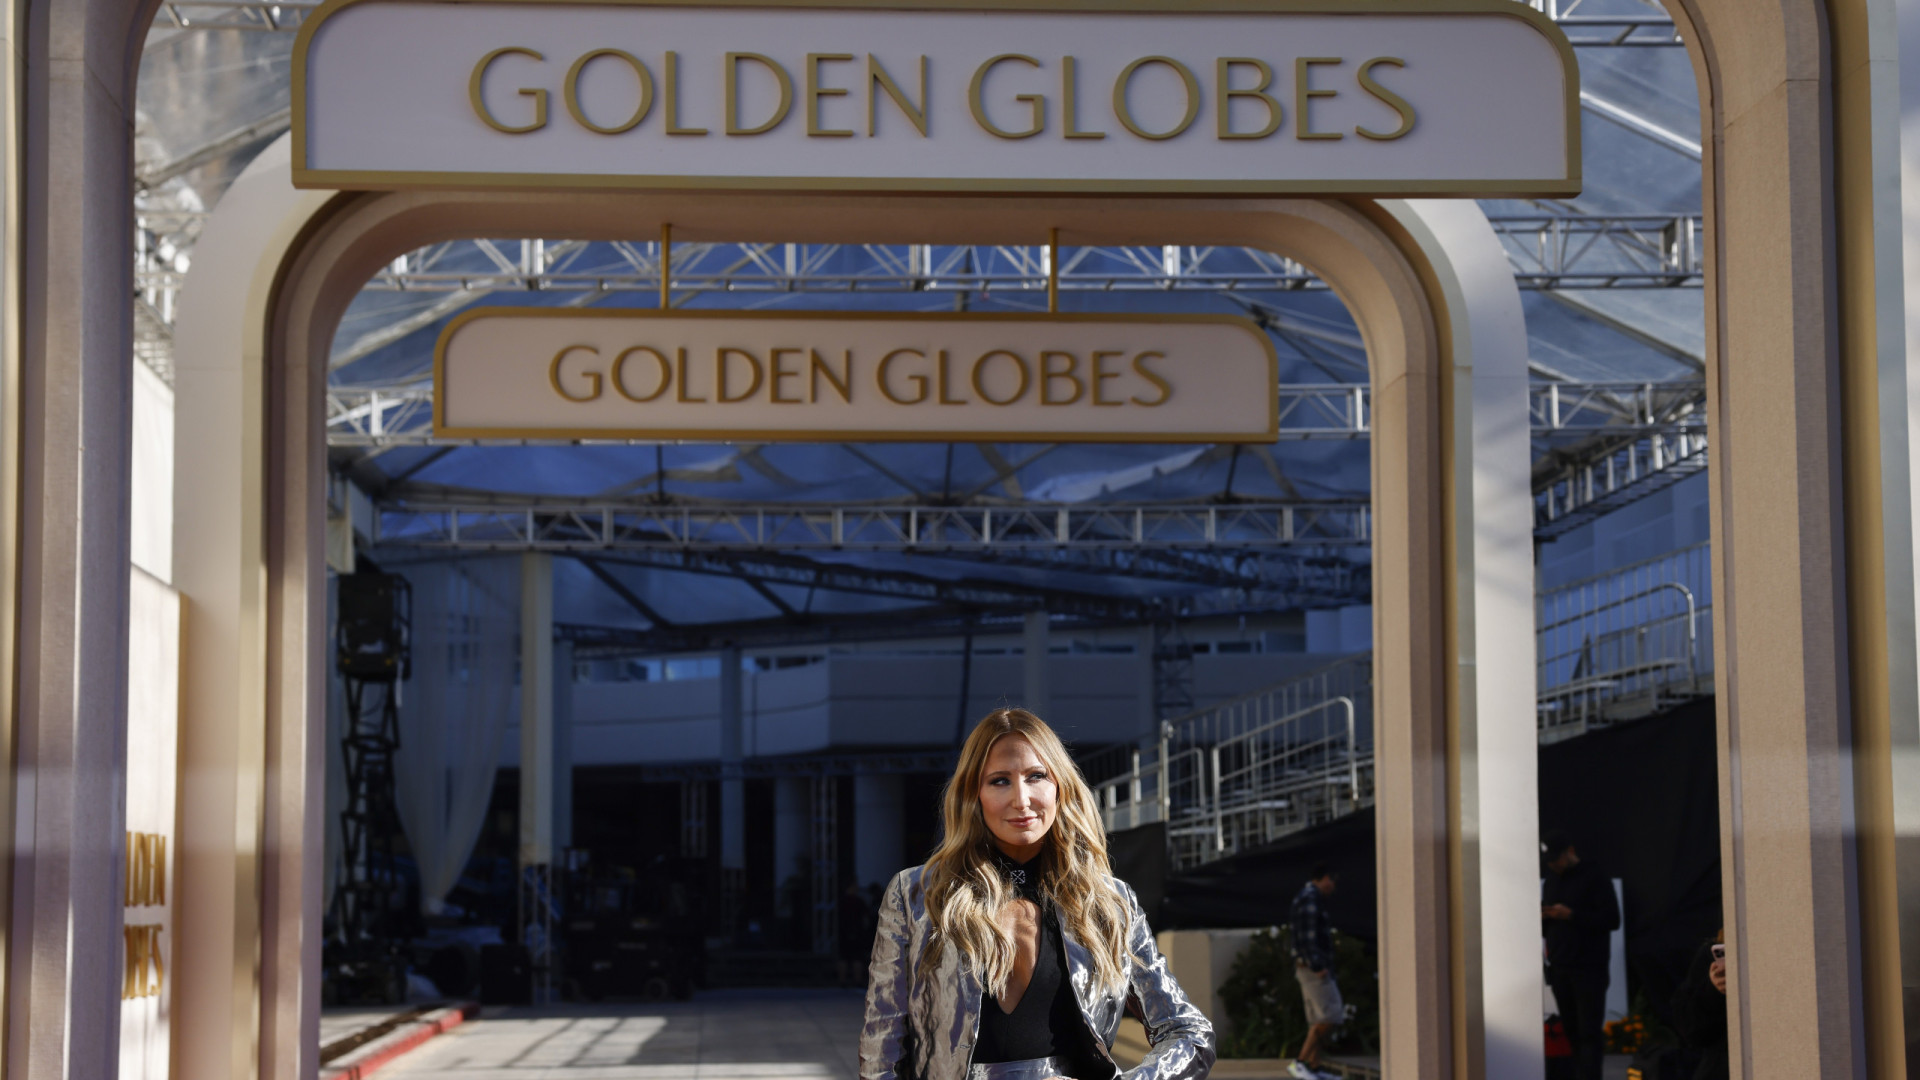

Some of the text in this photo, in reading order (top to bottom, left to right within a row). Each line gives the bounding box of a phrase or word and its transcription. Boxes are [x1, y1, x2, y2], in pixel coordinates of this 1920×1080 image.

[469, 47, 1417, 141] GOLDEN GLOBES
[549, 345, 1173, 407] GOLDEN GLOBES
